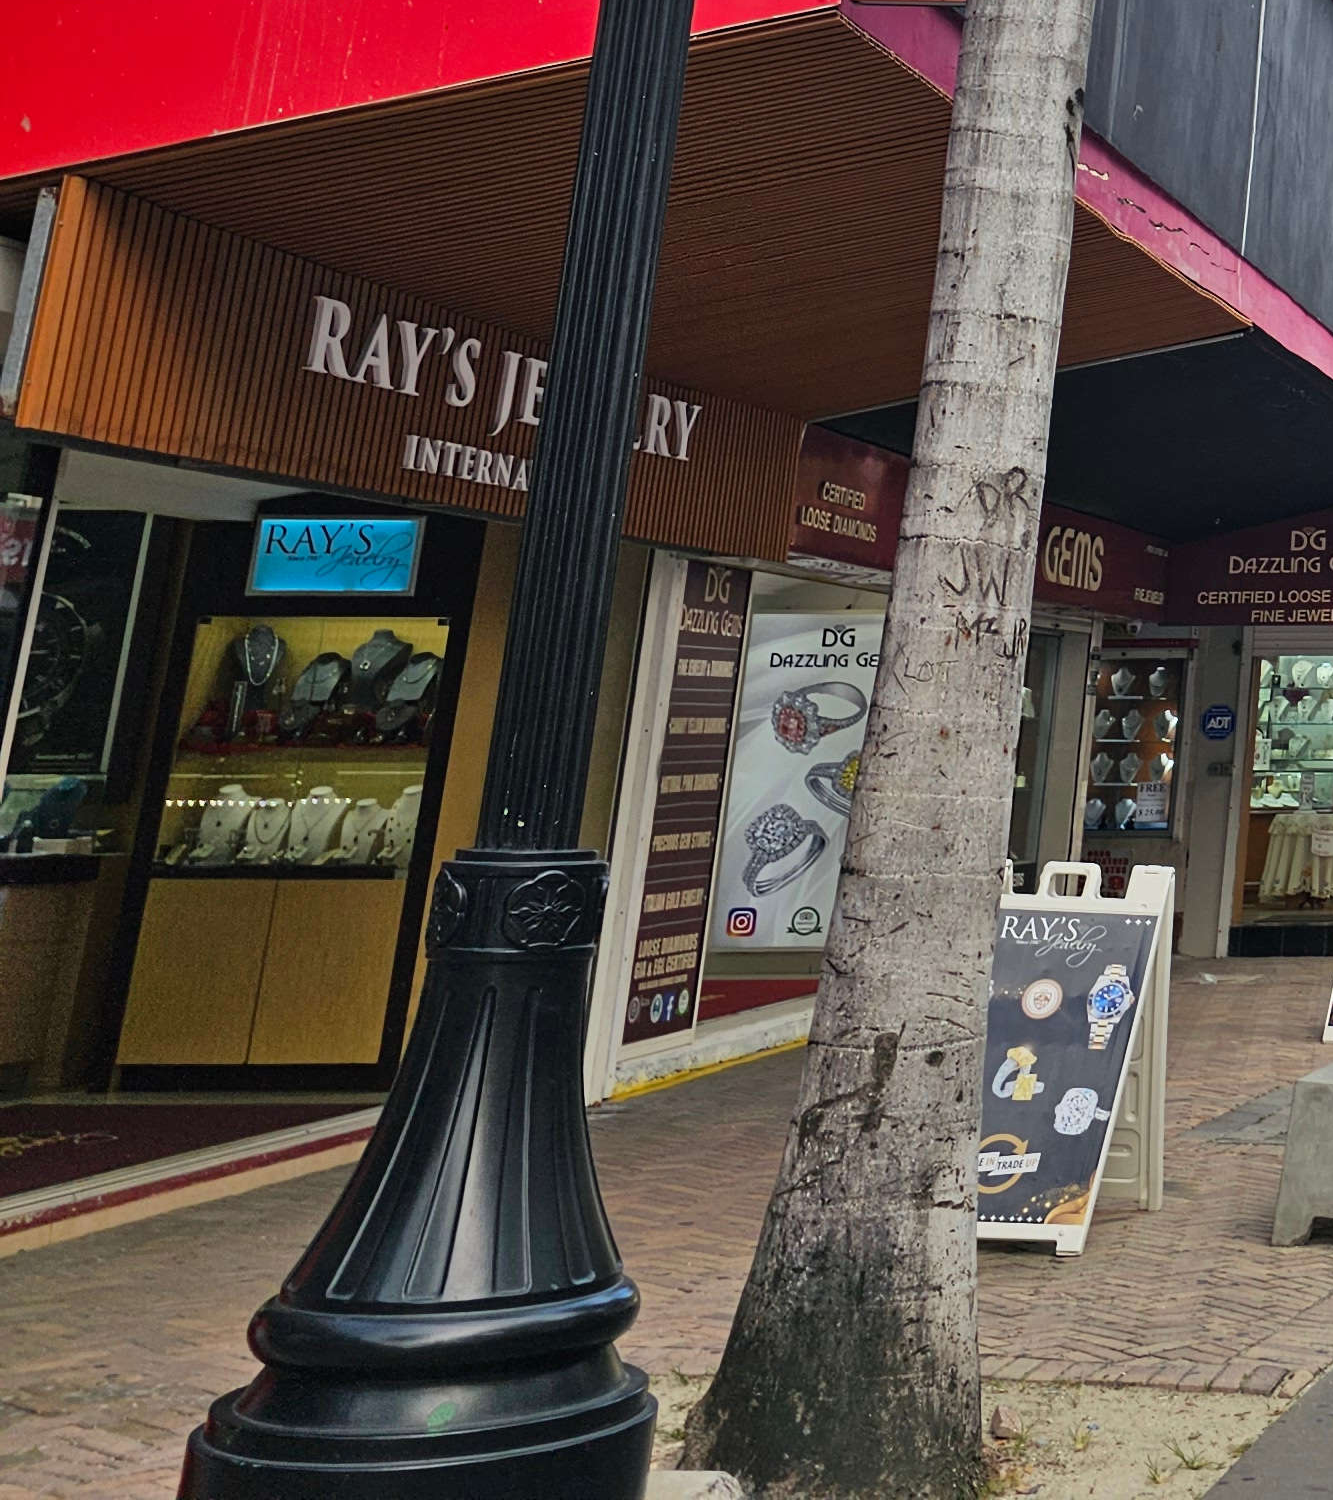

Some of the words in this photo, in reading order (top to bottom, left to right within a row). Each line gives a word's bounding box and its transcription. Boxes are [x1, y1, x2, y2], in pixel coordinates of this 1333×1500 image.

[302, 295, 482, 408] RAY'S
[402, 434, 533, 492] INTERNA
[822, 481, 867, 511] CERTIFIED
[801, 505, 833, 531] LOOSE
[833, 515, 877, 542] DIAMONDS
[264, 523, 374, 555] RAY'S
[1290, 529, 1327, 551] DG
[1043, 525, 1105, 592] GEMS
[1228, 554, 1321, 575] DAZZLING
[704, 568, 732, 604] DG
[1197, 590, 1276, 605] CERTIFIED
[1279, 589, 1331, 604] LOOSE
[679, 604, 719, 636] DAZZLING
[720, 609, 744, 638] GEMS
[1250, 609, 1285, 623] FINE
[822, 627, 857, 648] DG
[769, 652, 849, 668] DAZZLING
[1207, 716, 1232, 729] ADT
[1000, 915, 1081, 942] RAY'S
